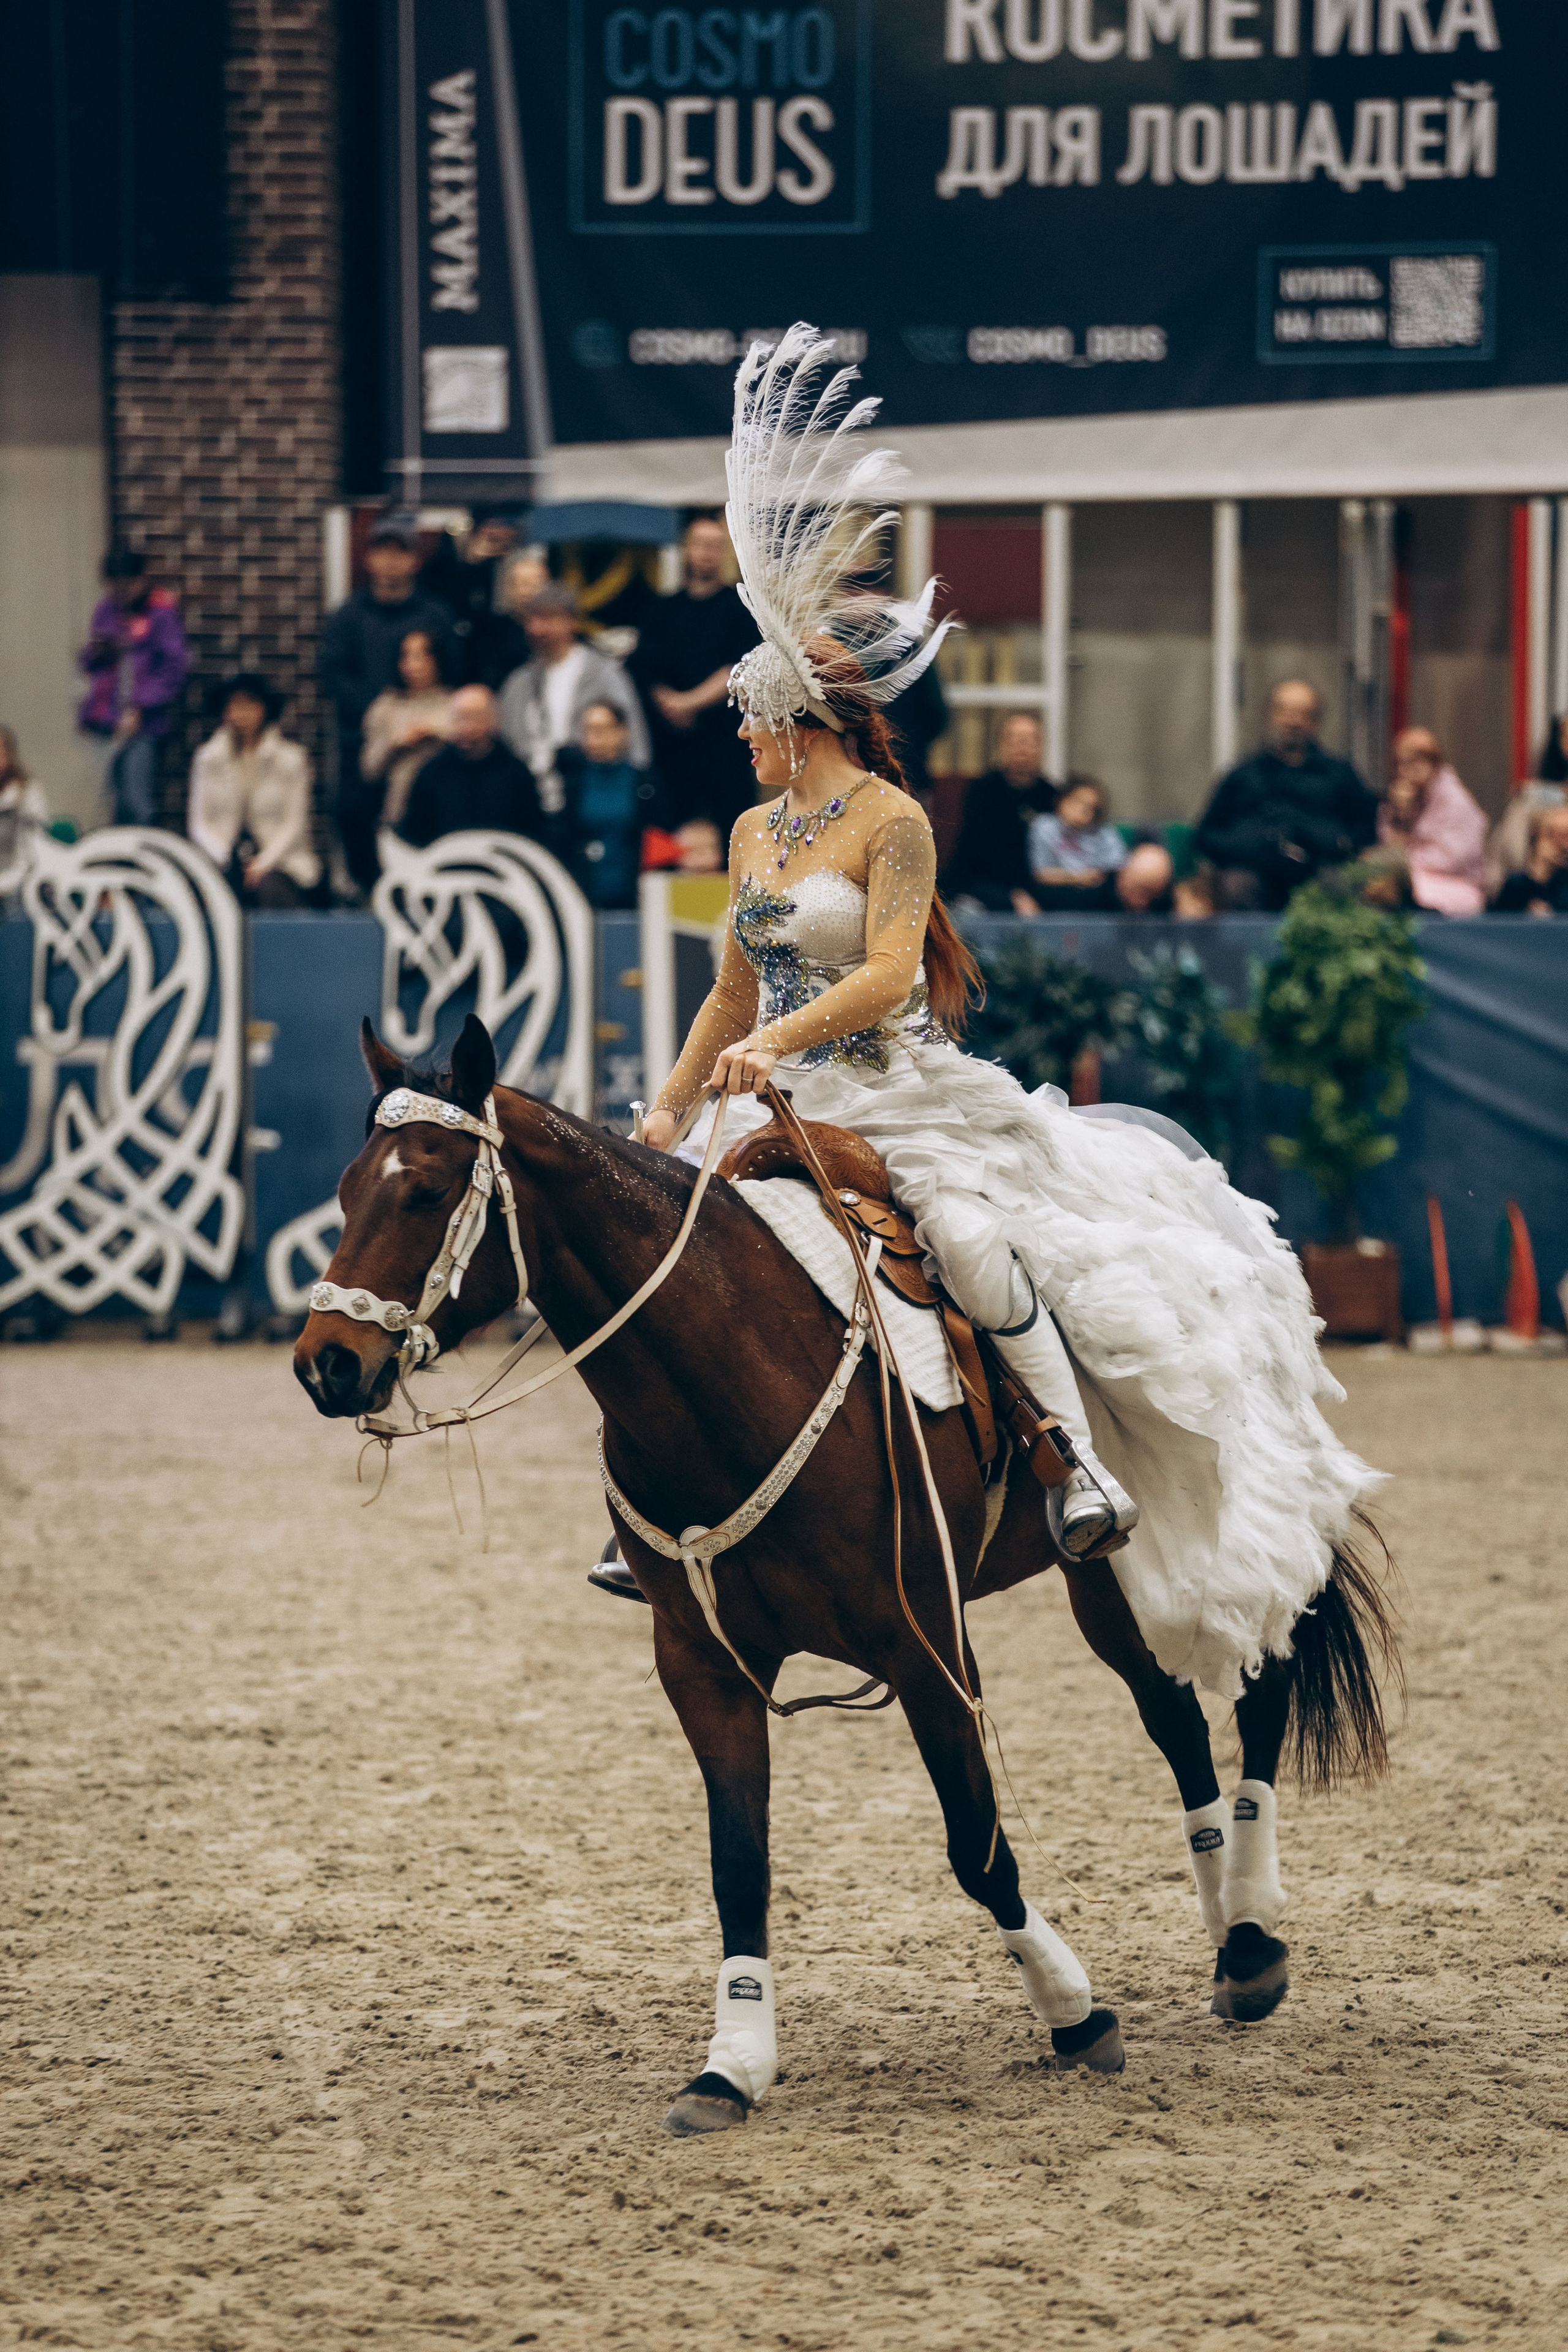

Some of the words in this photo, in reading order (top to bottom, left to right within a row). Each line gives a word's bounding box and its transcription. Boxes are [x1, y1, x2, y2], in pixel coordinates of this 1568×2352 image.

[605, 7, 835, 89] COSMO
[428, 69, 480, 314] MAXIMA
[603, 94, 835, 206] DEUS
[935, 104, 1102, 198] ДЛЯ
[1117, 80, 1499, 192] ЛОШАДЕЙ
